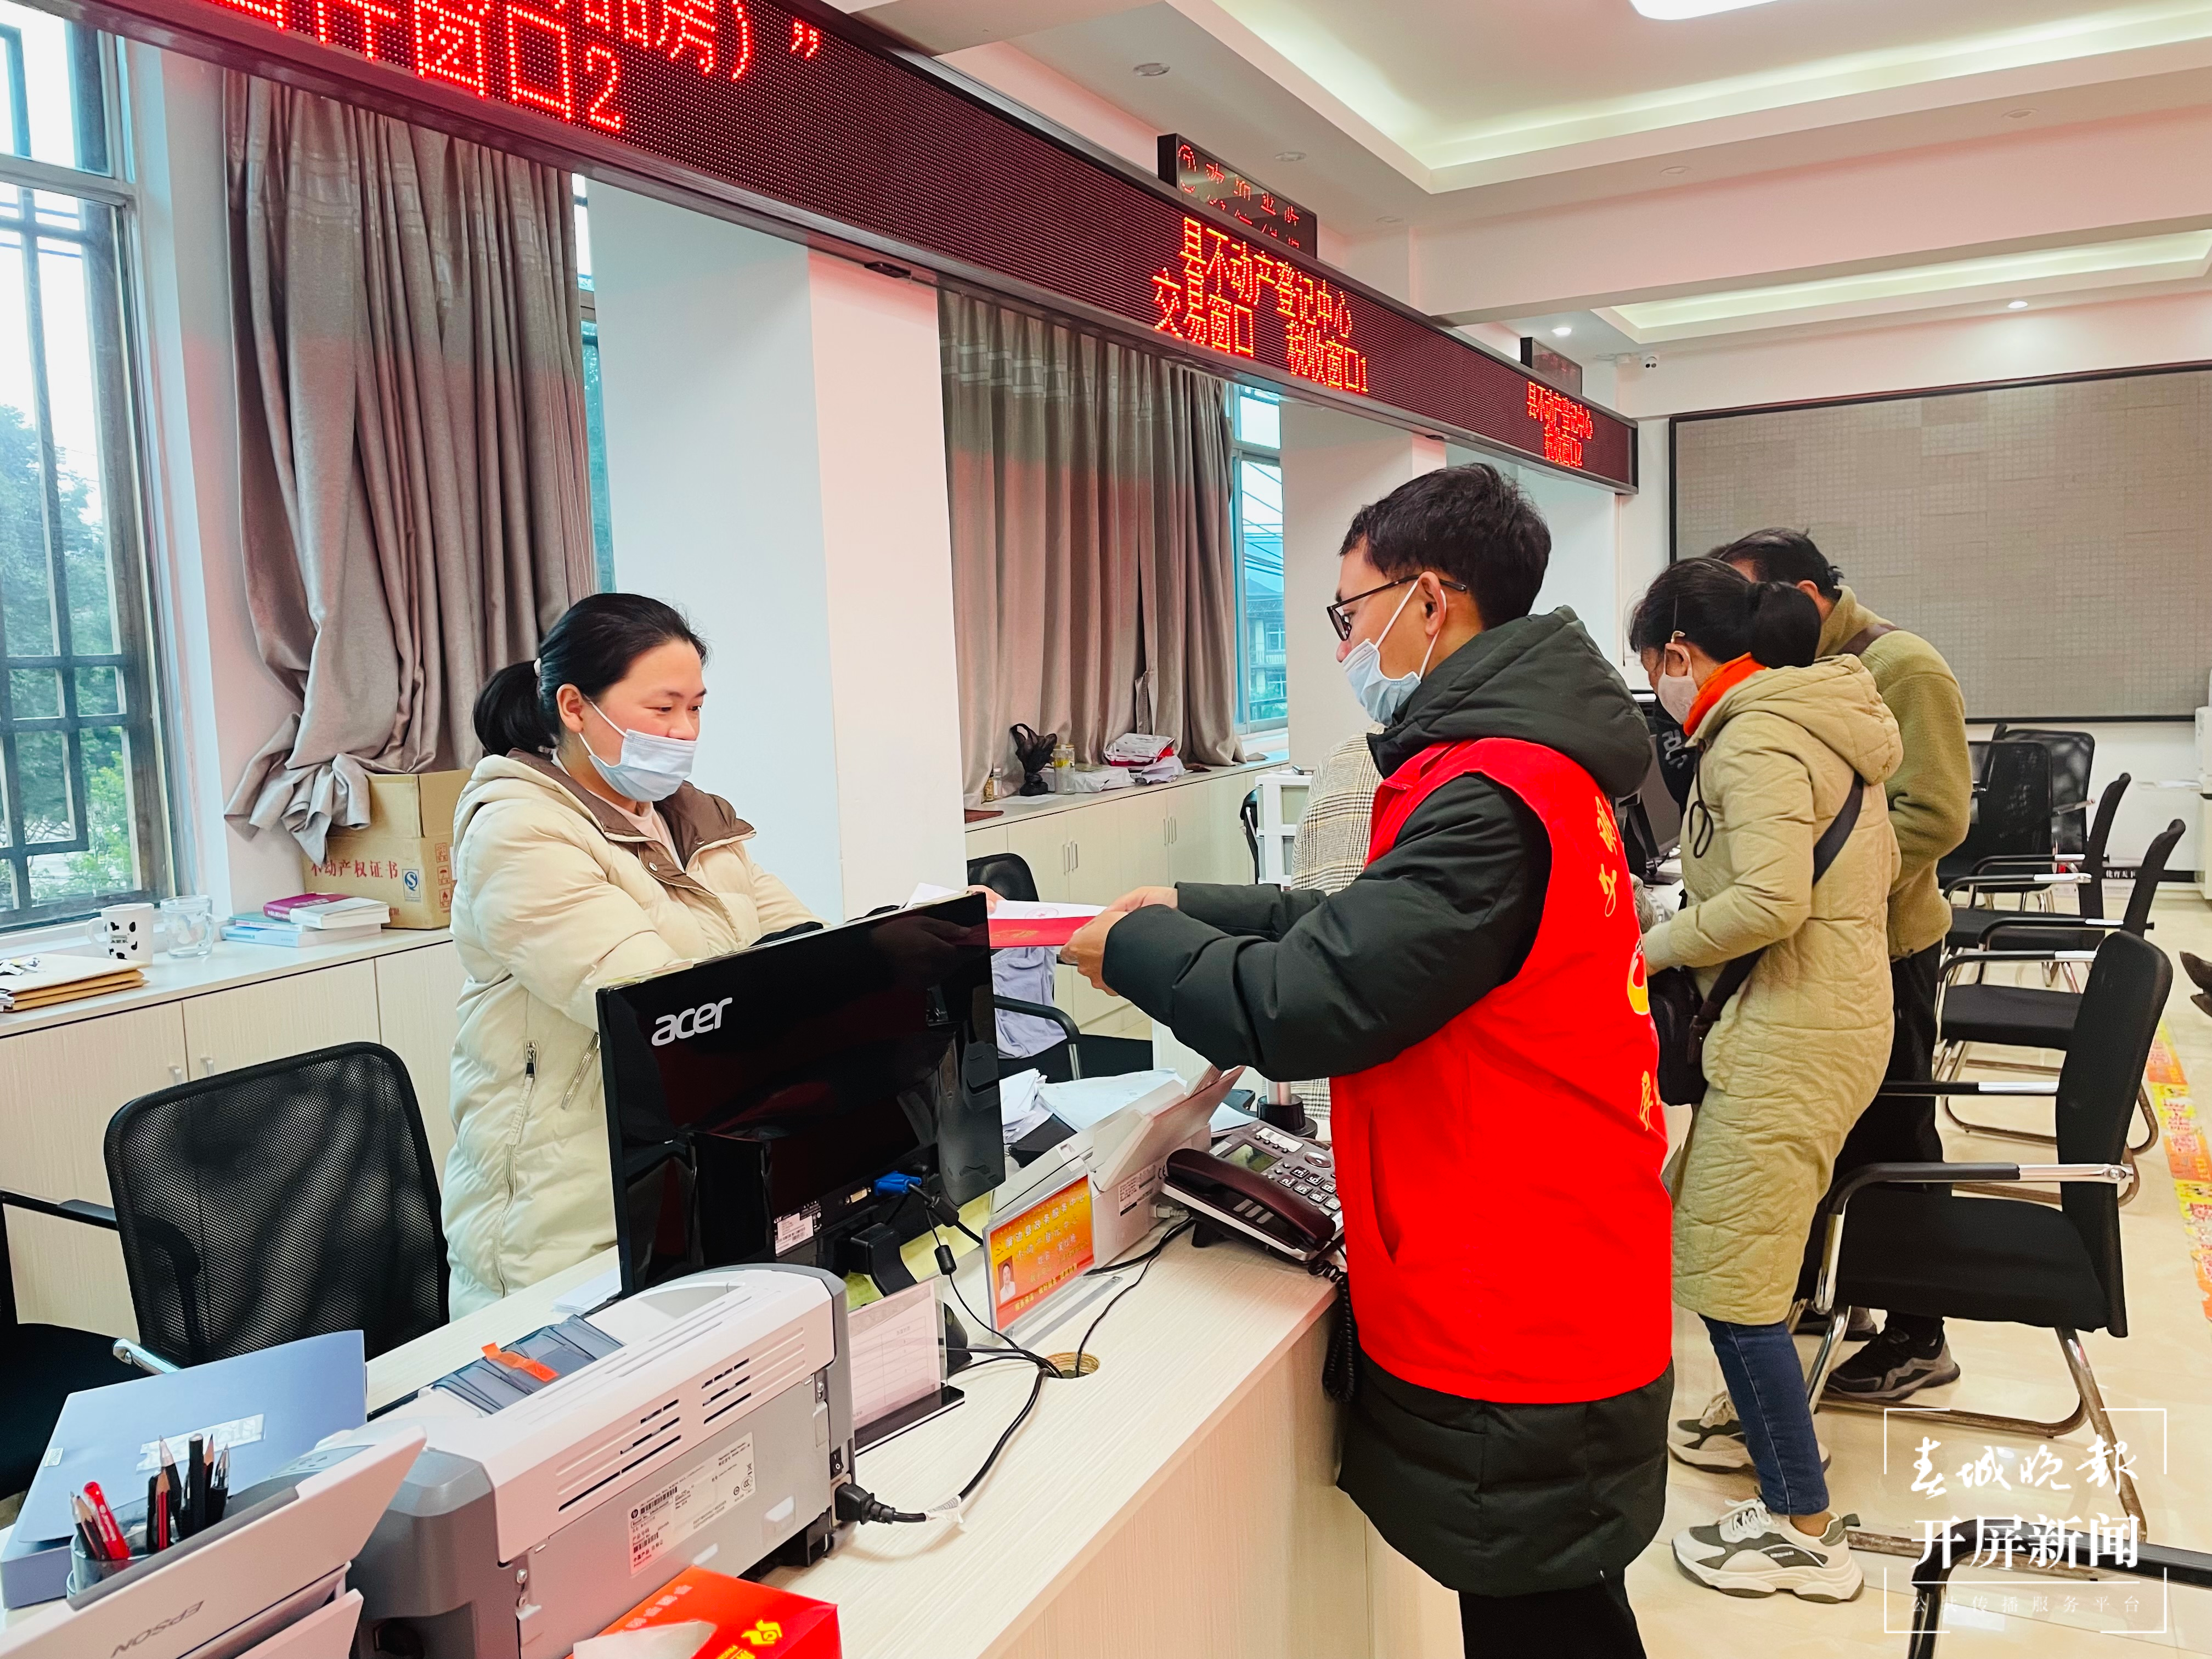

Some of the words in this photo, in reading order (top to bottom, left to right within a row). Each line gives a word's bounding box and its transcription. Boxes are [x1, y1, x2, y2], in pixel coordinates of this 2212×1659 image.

[1180, 216, 1353, 339] 县不动产登记中心
[1152, 267, 1255, 358] 交易窗口
[311, 859, 398, 879] 不动产权证书
[651, 997, 733, 1046] acer
[1005, 1193, 1085, 1249] 屏边县政务服务中心
[110, 1600, 205, 1658] EPSON
